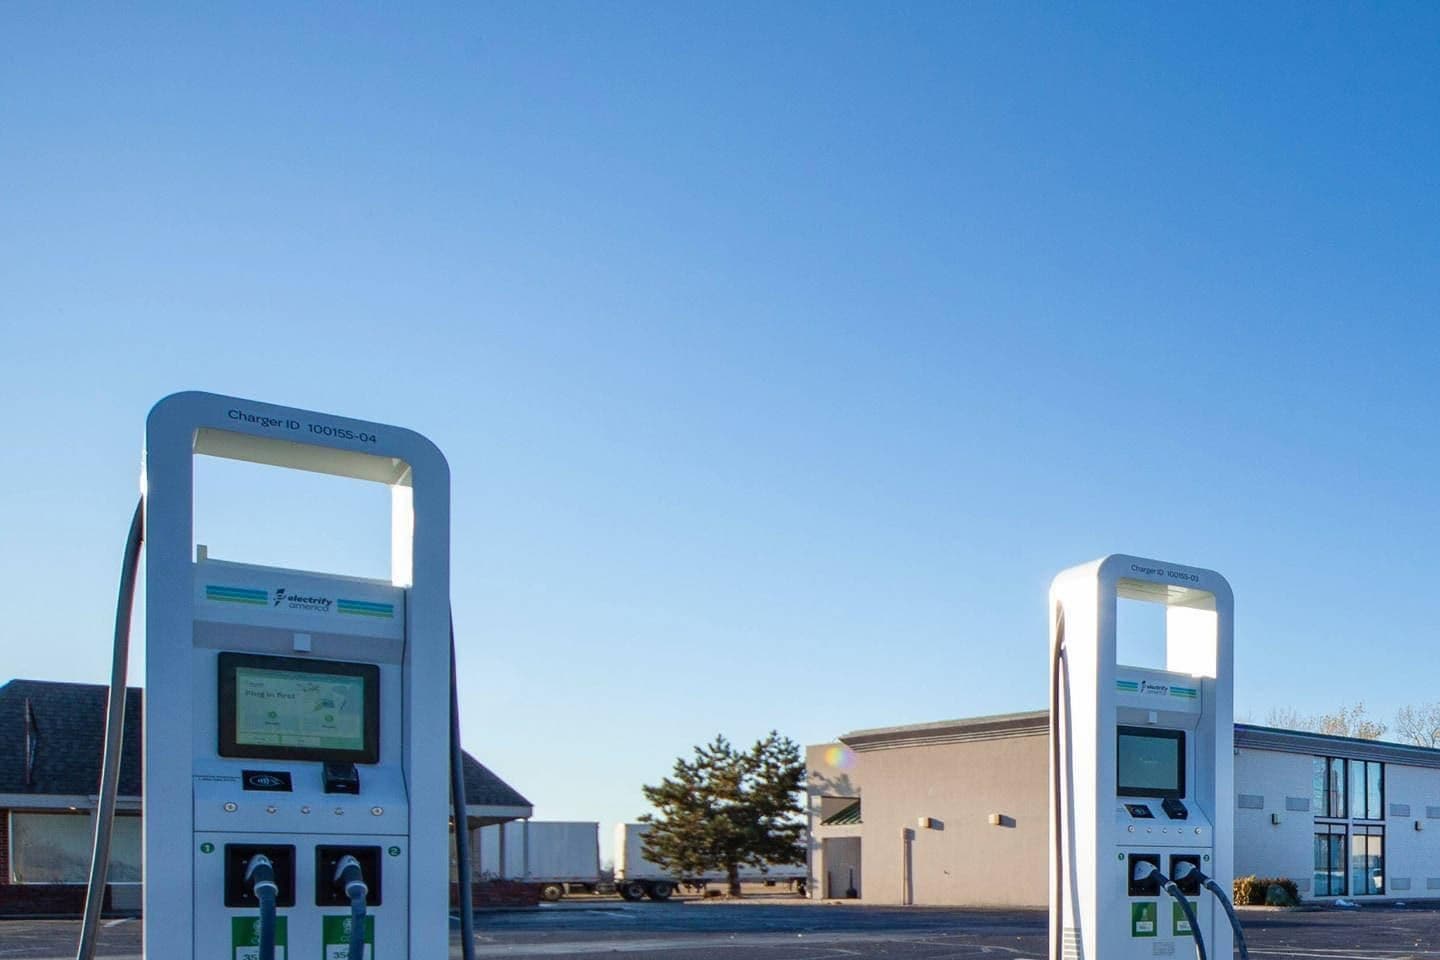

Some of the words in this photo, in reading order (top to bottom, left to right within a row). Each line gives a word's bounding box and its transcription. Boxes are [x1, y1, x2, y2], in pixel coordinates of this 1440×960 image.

[228, 409, 283, 428] Charger
[286, 420, 300, 430] ID
[1131, 564, 1156, 575] Charger
[287, 595, 333, 606] electrify
